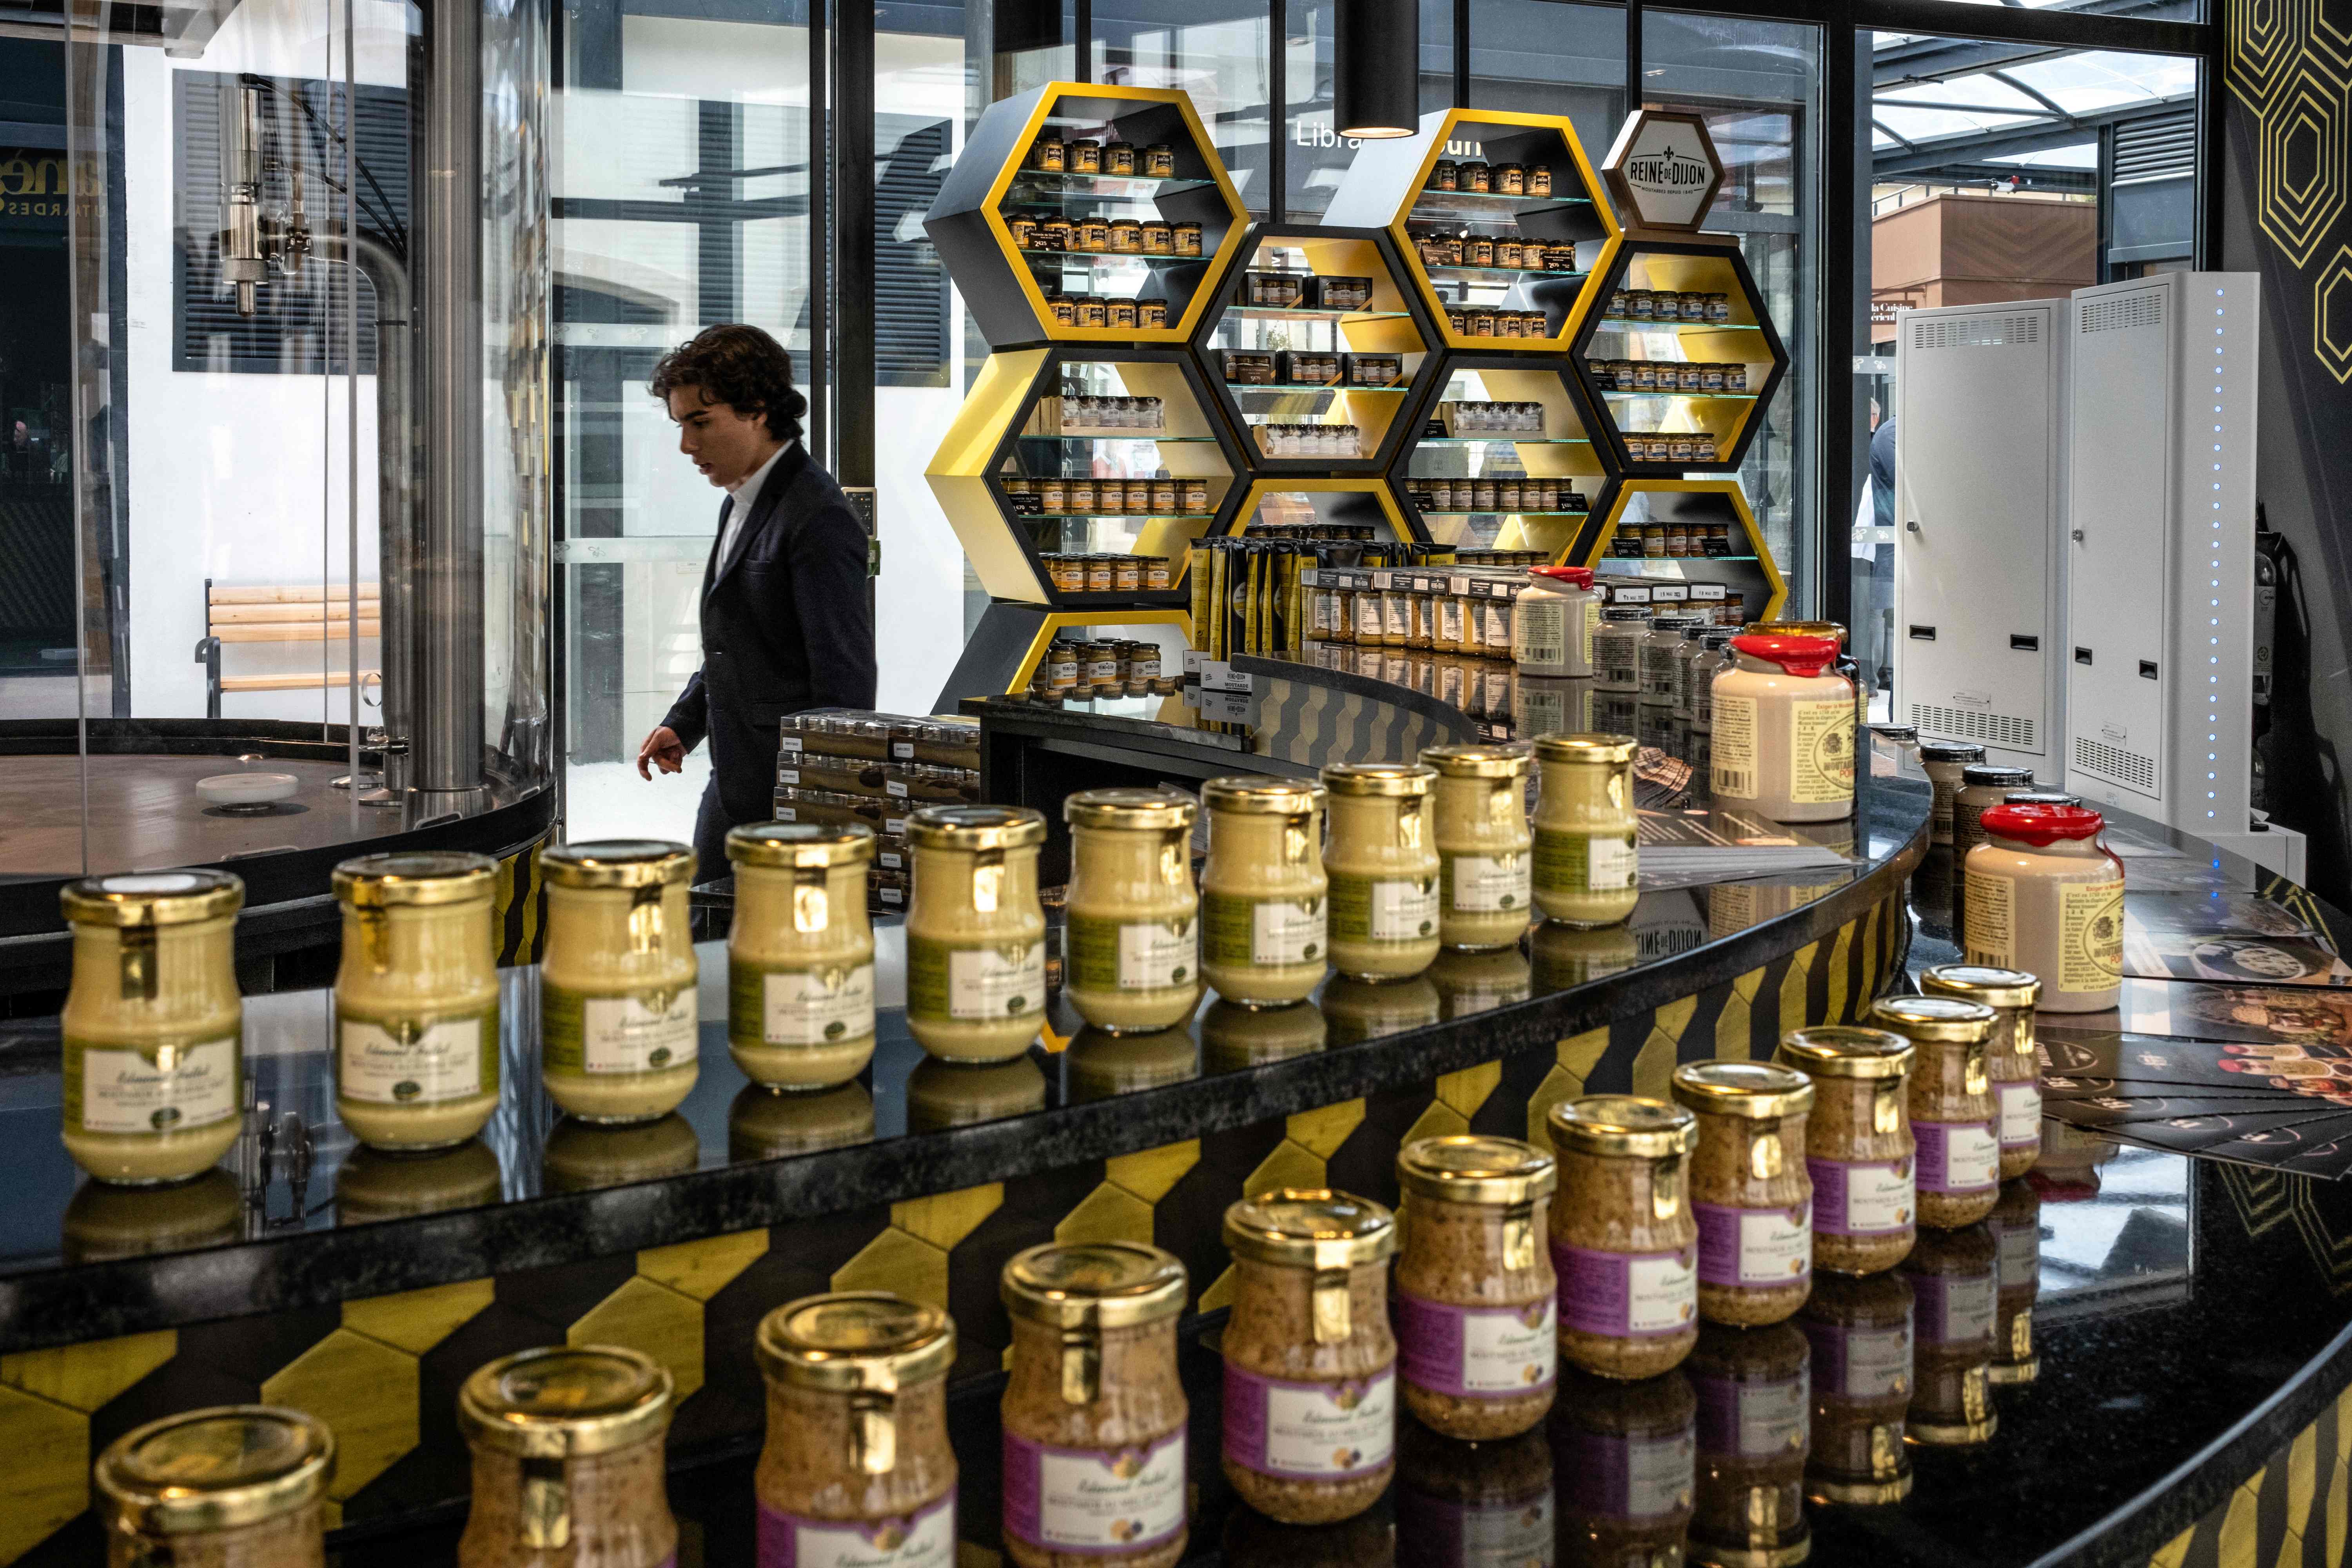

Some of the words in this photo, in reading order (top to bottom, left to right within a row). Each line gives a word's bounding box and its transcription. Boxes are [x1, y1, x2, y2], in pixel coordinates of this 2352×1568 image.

[1630, 161, 1664, 183] REINE
[1664, 168, 1671, 180] DE
[1672, 162, 1705, 185] DIJON
[1871, 303, 1879, 312] la
